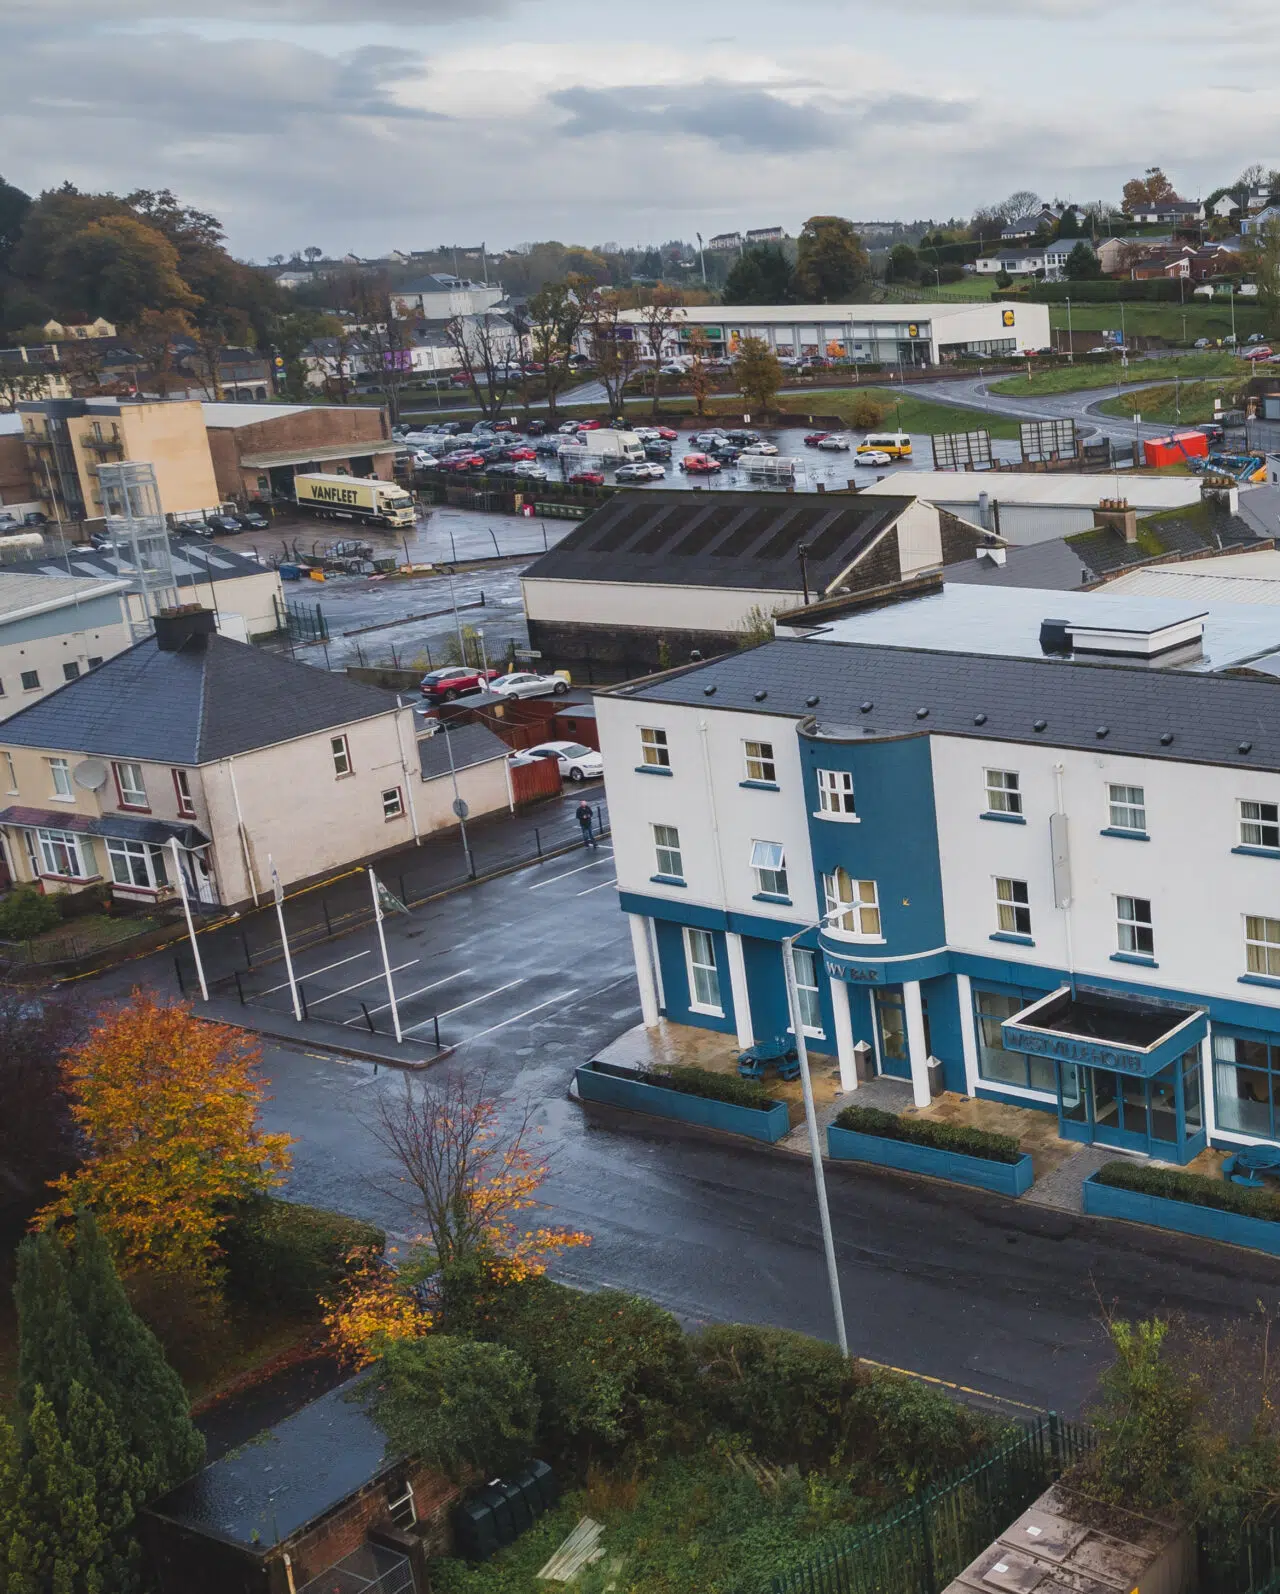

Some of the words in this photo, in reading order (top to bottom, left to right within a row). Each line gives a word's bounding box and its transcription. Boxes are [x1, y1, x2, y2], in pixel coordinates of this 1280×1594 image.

[311, 485, 358, 504] VANFLEET
[850, 967, 878, 981] BAR
[1091, 1051, 1143, 1071] HOTEL
